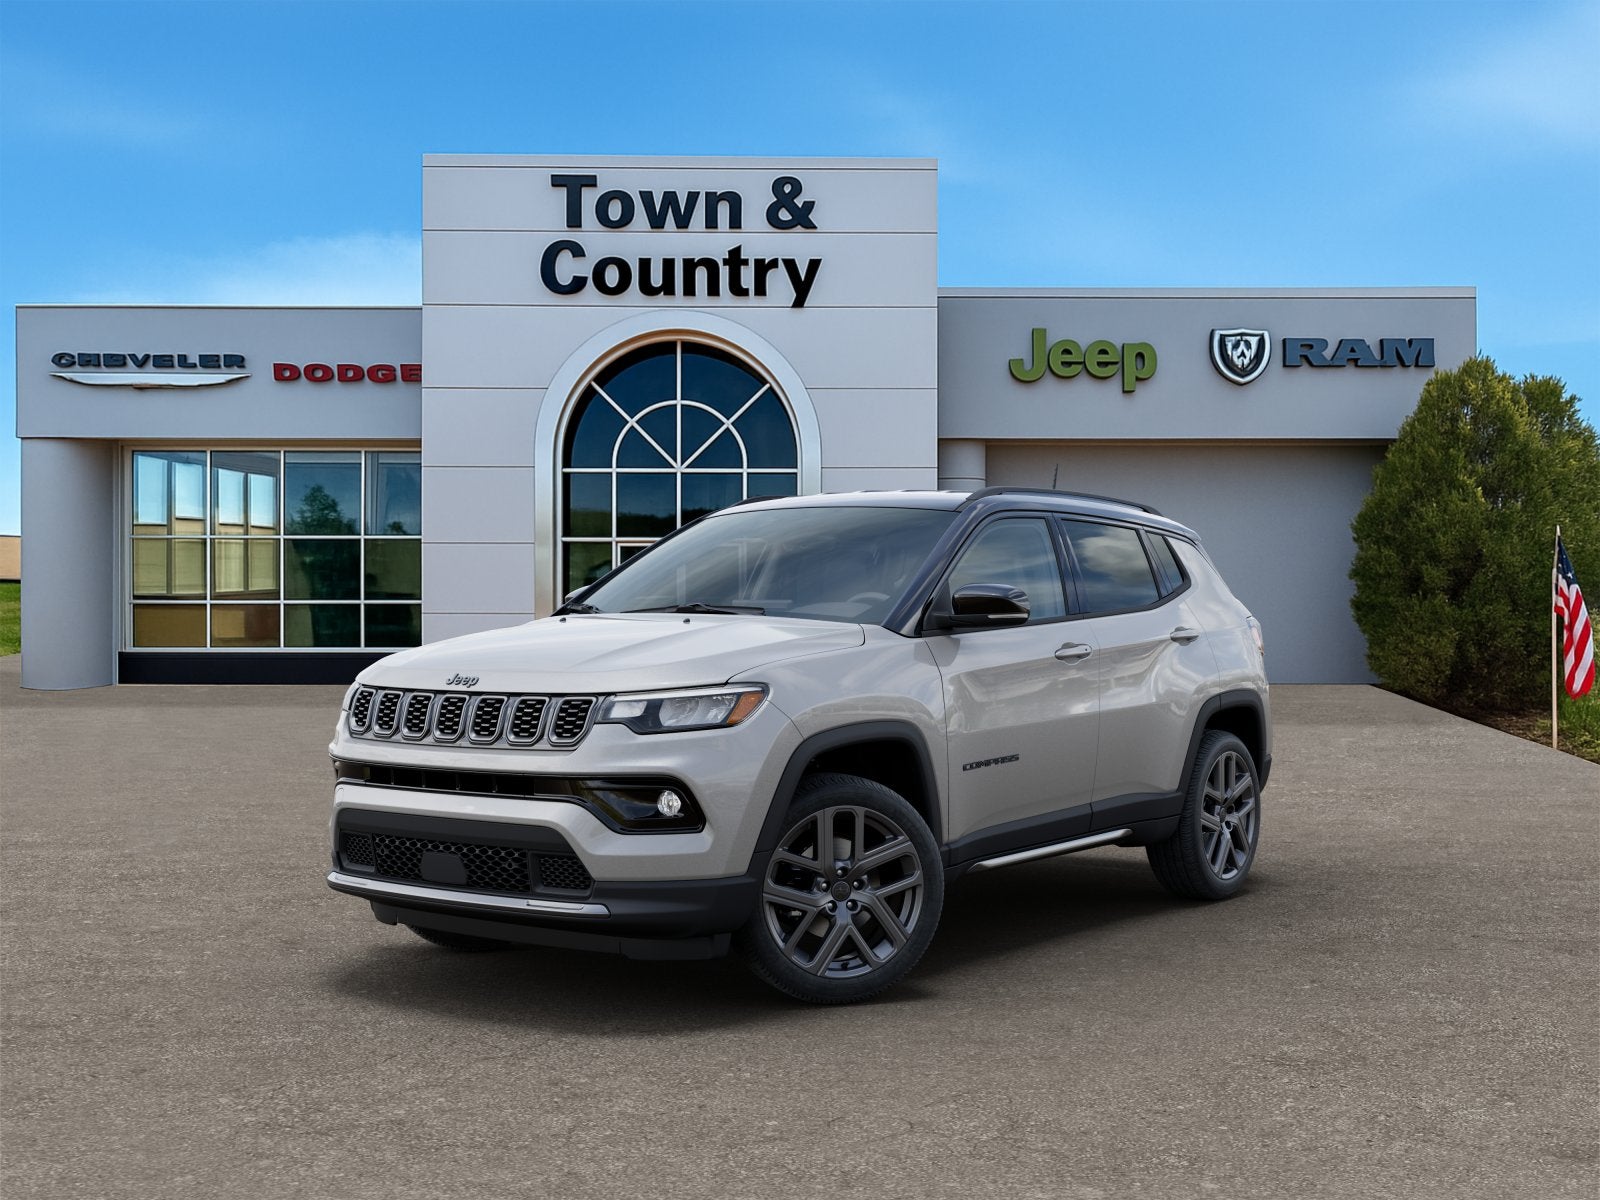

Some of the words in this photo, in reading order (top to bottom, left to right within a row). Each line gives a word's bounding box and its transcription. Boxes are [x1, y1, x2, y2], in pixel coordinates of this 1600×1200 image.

[550, 174, 743, 230] Town
[765, 175, 818, 230] &
[539, 239, 822, 308] Country
[273, 362, 421, 383] DODGE
[1009, 328, 1157, 392] Jeep
[1282, 337, 1435, 367] RAM
[446, 673, 479, 688] Jeep
